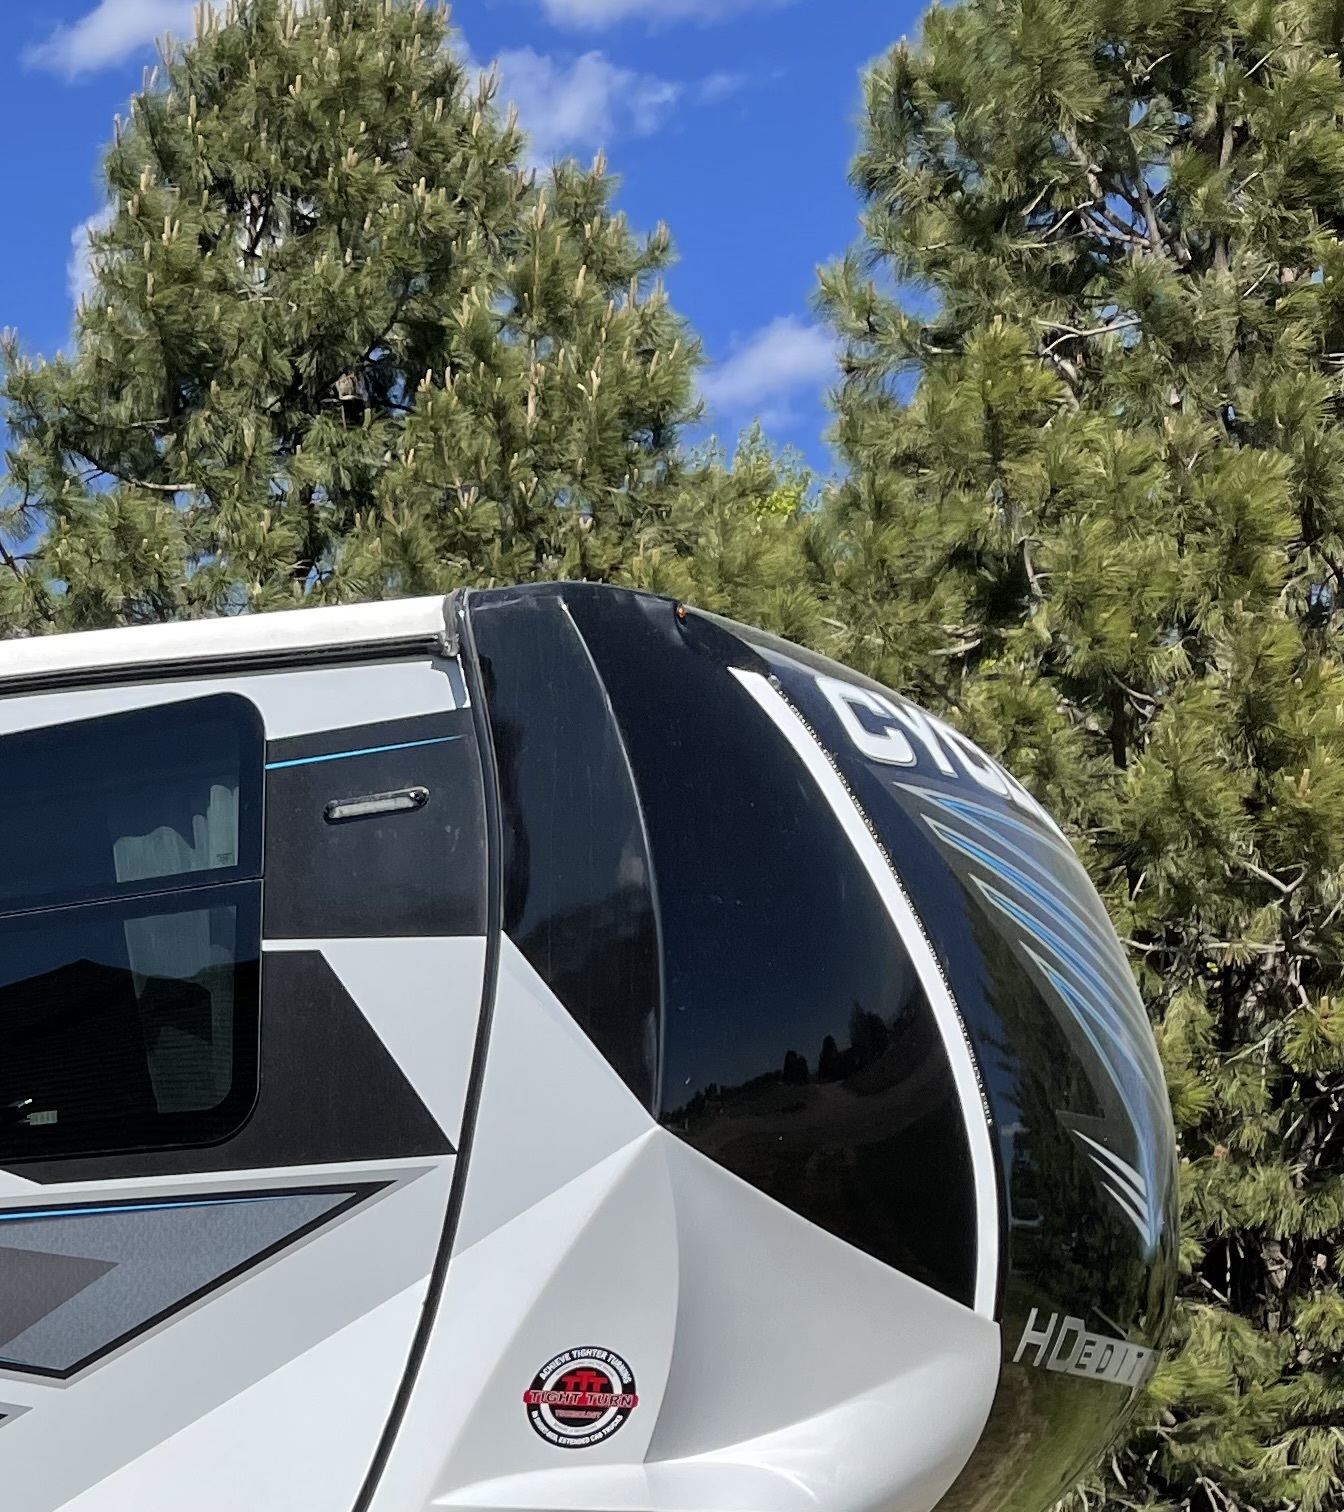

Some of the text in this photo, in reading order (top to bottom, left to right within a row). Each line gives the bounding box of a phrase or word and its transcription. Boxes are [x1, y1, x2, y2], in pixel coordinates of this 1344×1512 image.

[539, 1352, 572, 1380] ACHIEVE
[571, 1348, 609, 1360] TIGHTER
[607, 1353, 633, 1384] TURNING
[529, 1389, 634, 1408] TIGHT TURN
